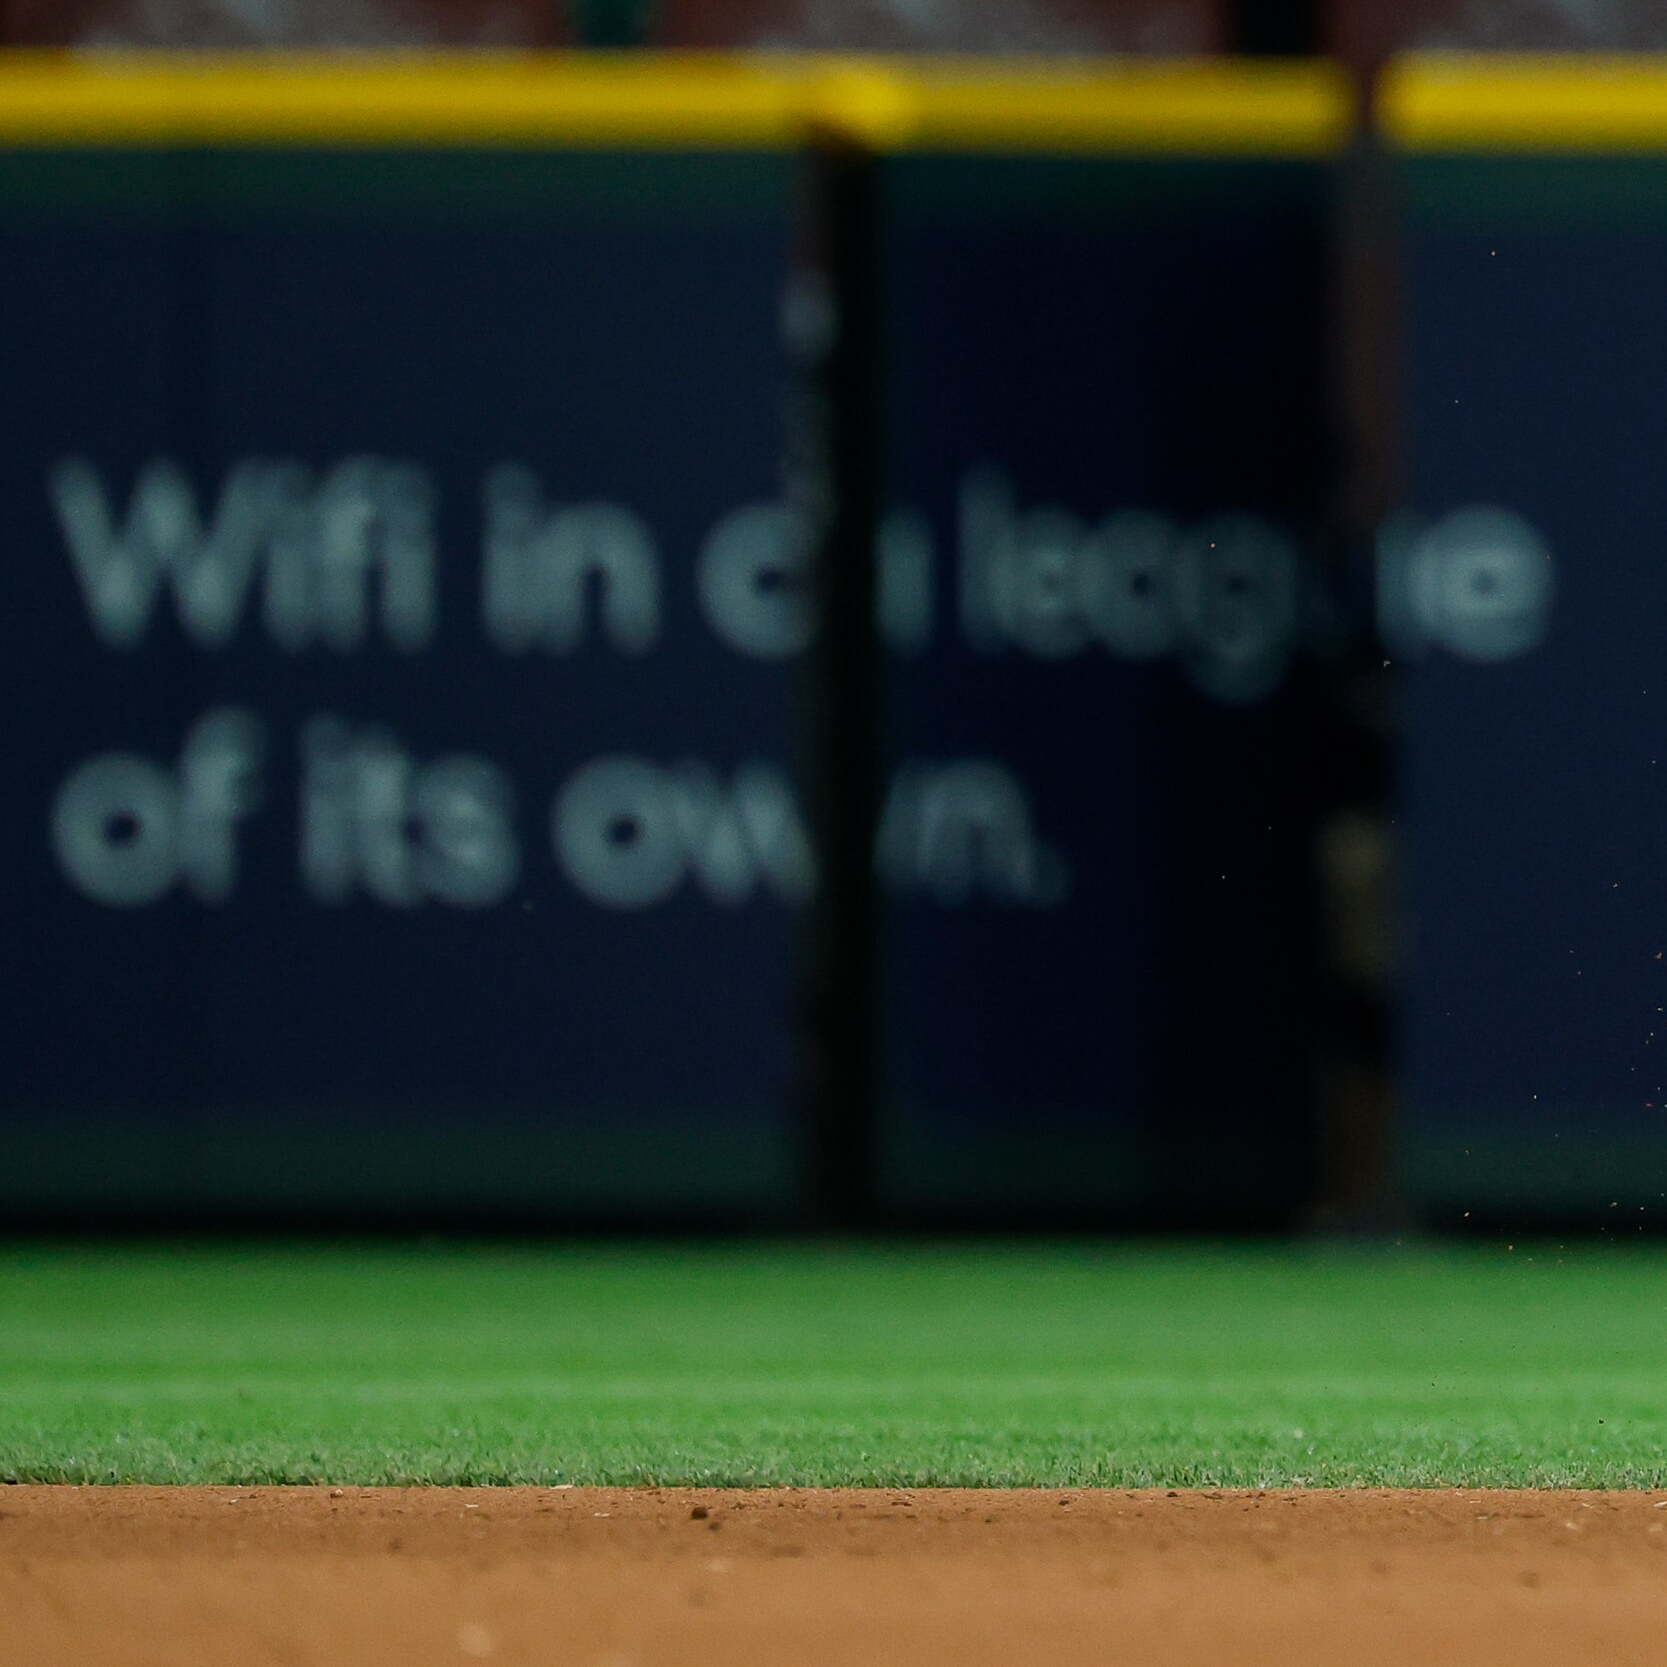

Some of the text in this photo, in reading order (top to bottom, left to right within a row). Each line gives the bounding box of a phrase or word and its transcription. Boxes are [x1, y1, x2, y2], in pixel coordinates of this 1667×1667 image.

[50, 458, 435, 648] Wifi
[483, 461, 660, 650] in
[52, 711, 265, 906] of
[303, 721, 518, 906] its
